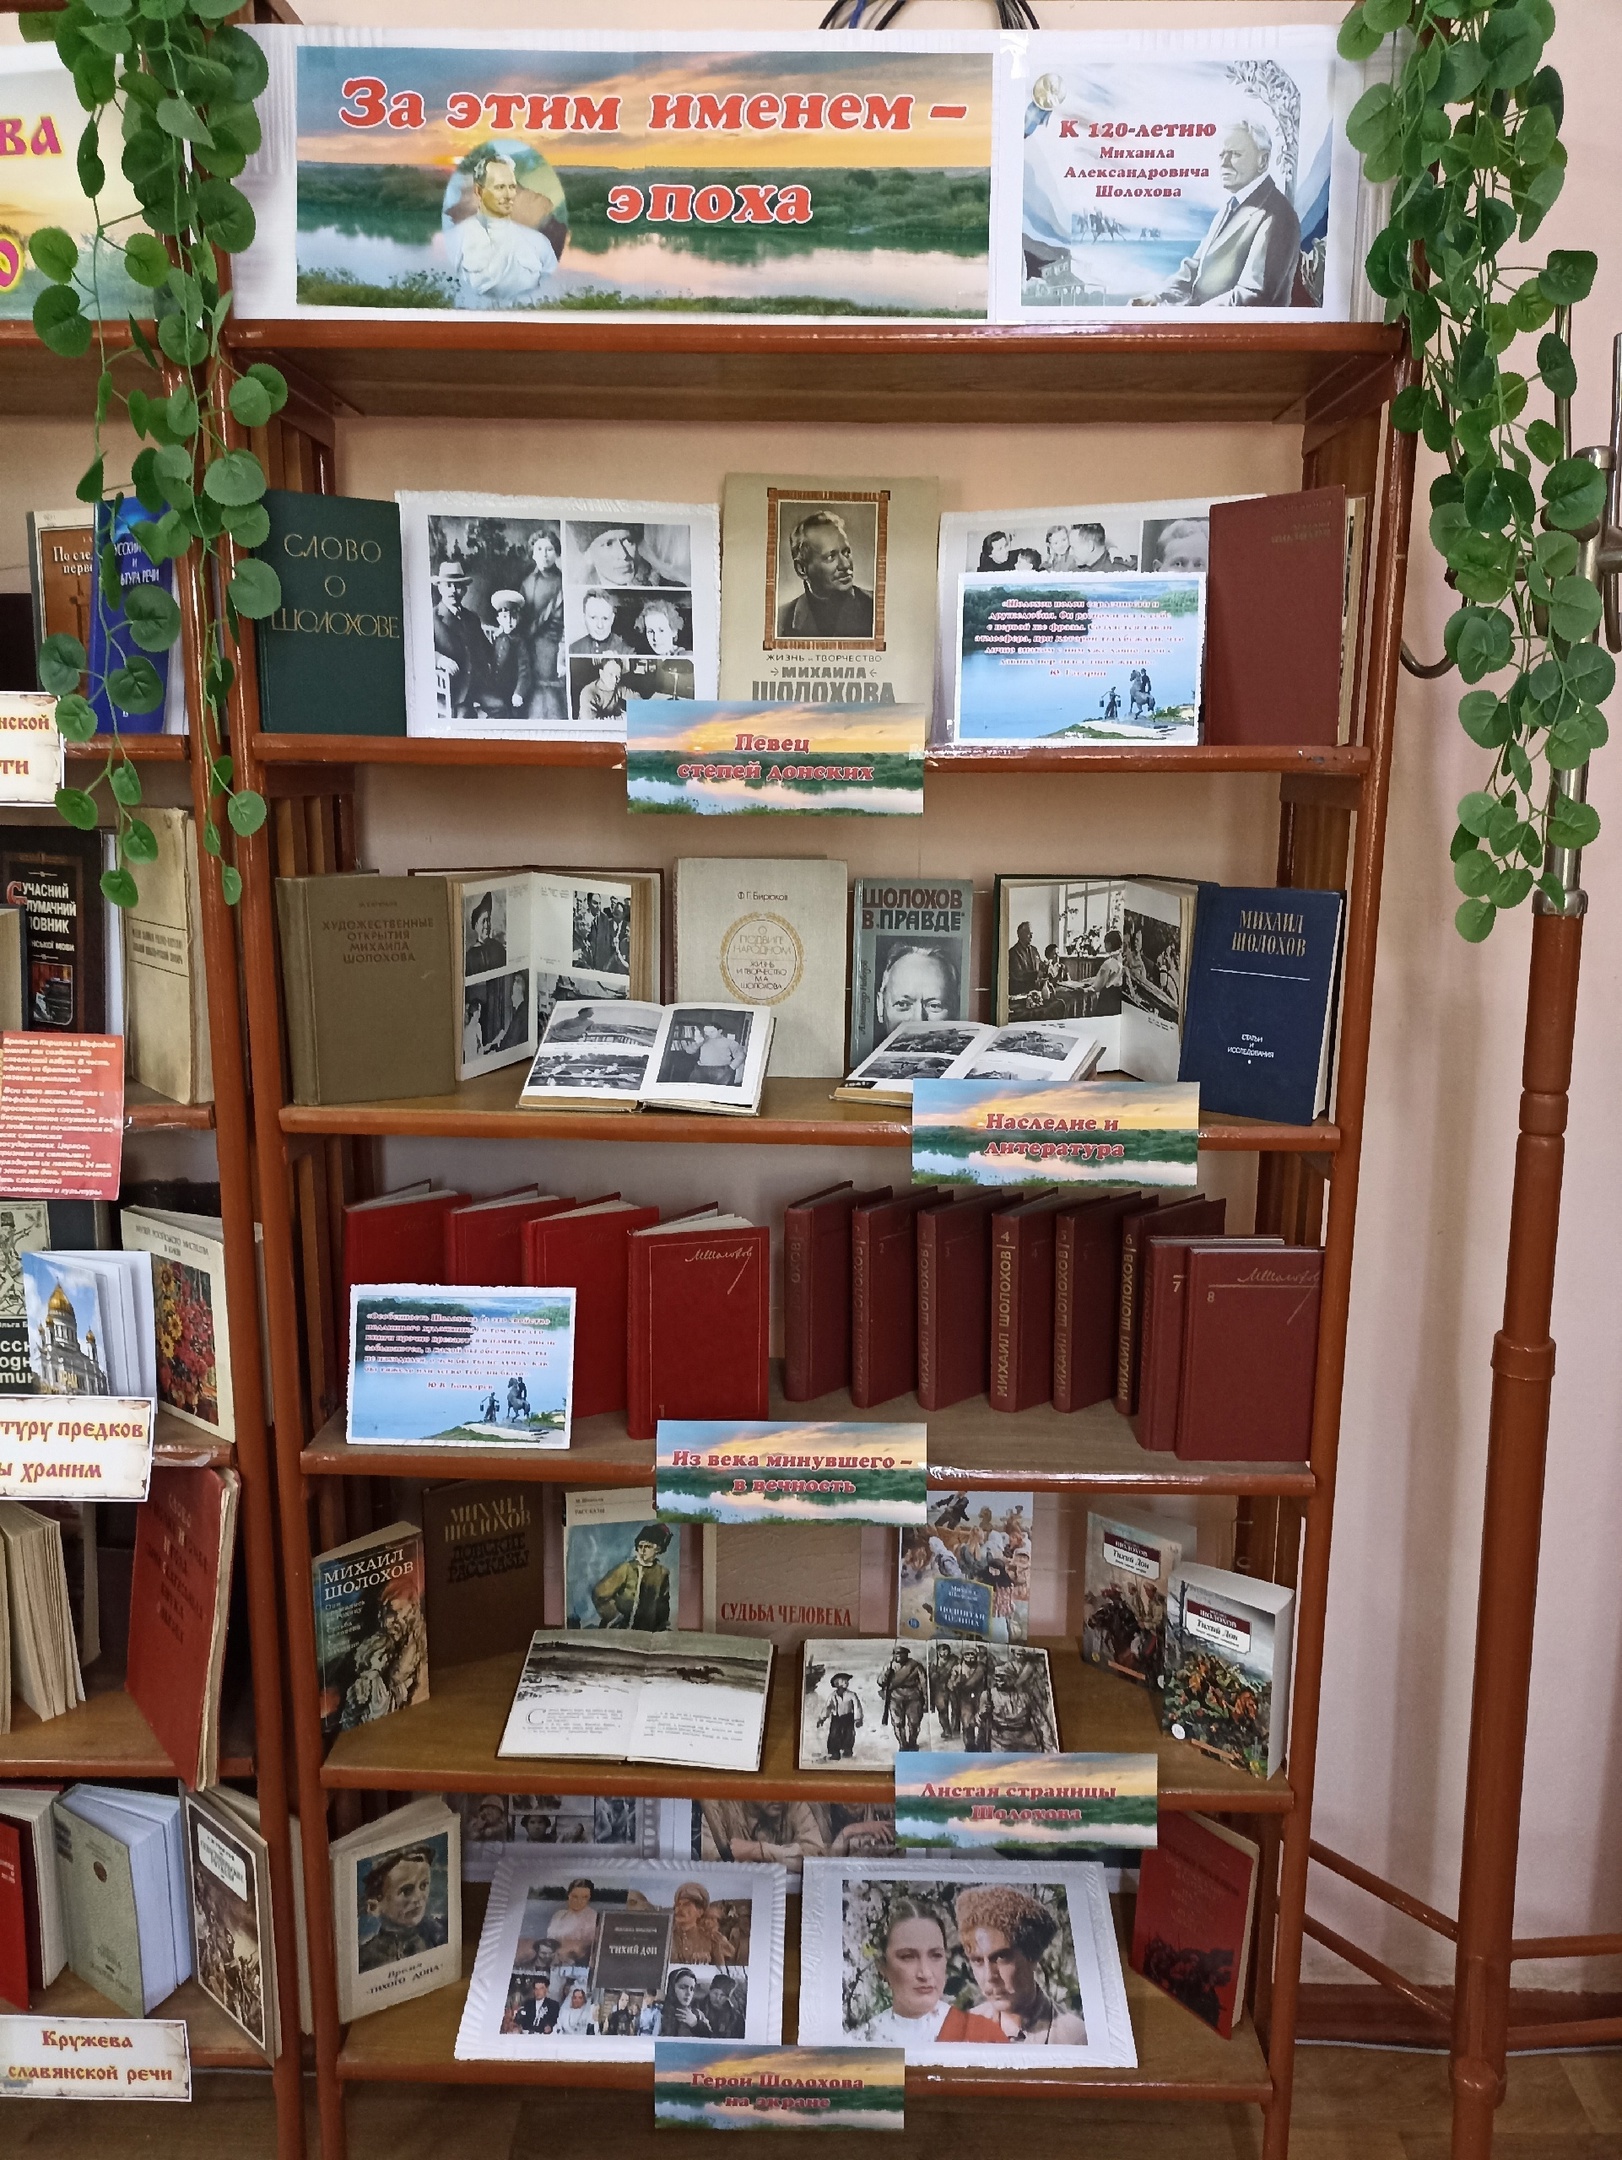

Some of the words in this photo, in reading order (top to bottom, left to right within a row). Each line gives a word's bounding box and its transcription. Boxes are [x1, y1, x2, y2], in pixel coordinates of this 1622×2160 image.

[338, 75, 426, 131] За
[445, 90, 623, 133] этим
[648, 92, 911, 132] именем
[1059, 120, 1079, 139] К
[1088, 119, 1217, 140] 120-летию
[1099, 145, 1175, 161] Михаила
[1064, 165, 1210, 182] Александровича
[1095, 184, 1182, 200] Шолохова
[606, 182, 812, 225] эпоха
[53, 546, 70, 562] По
[73, 550, 93, 561] сле
[284, 533, 382, 564] СЛОВО
[324, 575, 347, 598] О
[271, 609, 400, 640] ШОЛОХОВЕ
[766, 654, 804, 662] ЖИЗНЬ
[815, 654, 882, 663] ТВОРЧЕСТВО
[782, 666, 866, 679] МИХАИЛА
[752, 680, 896, 703] ШОЛОХОВА
[735, 733, 810, 754] Певец
[677, 760, 761, 780] степей
[766, 763, 874, 781] донских
[863, 888, 962, 909] ШОЛОХОВ
[29, 916, 70, 934] ОВНИК
[322, 918, 434, 931] ХУДОЖЕСТВЕННЫЕ
[862, 910, 874, 930] В
[1239, 910, 1304, 934] МИХАИЛ
[347, 930, 410, 941] ОТКРЫТИЯ
[1231, 932, 1307, 957] ШОЛОХОВ
[350, 941, 409, 952] МИХАИЛА
[343, 952, 416, 964] ШОЛОХОВА
[1227, 1046, 1275, 1059] ИССЛЕДОВАНИЯ
[985, 1113, 1097, 1132] Наследие
[1104, 1117, 1119, 1132] и
[985, 1141, 1125, 1158] литература
[1000, 1231, 1011, 1243] 4
[920, 1248, 930, 1325] ШОЛОХОВ
[998, 1251, 1012, 1328] ШОЛОХОВ
[1057, 1250, 1069, 1327] ШОЛОХОВ
[1121, 1253, 1134, 1331] ШОЛОХОВ
[1173, 1281, 1181, 1293] 7
[1207, 1291, 1216, 1303] 8
[997, 1333, 1010, 1398] МИХАИЛ
[1056, 1332, 1067, 1396] МИХАИЛ
[1118, 1339, 1130, 1401] МИХАИЛ
[57, 1421, 143, 1442] предков
[672, 1451, 701, 1467] Из
[708, 1454, 759, 1467] века
[766, 1454, 895, 1471] минувшего
[20, 1463, 102, 1483] храним
[733, 1479, 746, 1492] в
[753, 1478, 856, 1494] вечность
[450, 1495, 524, 1523] МИХАИЛ
[444, 1509, 531, 1543] ШОЛОХОВ
[323, 1548, 404, 1585] МИХАИЛ
[324, 1561, 414, 1601] ШОЛОХОВ
[721, 1602, 774, 1623] СУДЬБА
[778, 1603, 852, 1627] ЧЕЛОВЕКА
[920, 1782, 999, 1799] Листая
[1006, 1786, 1117, 1802] страницы
[971, 1804, 1082, 1822] Шолохова
[42, 2030, 133, 2051] Кружева
[8, 2065, 118, 2081] славянской
[126, 2069, 173, 2085] речи
[690, 2072, 754, 2088] Герои
[759, 2073, 864, 2090] Шолохова
[725, 2096, 749, 2107] на
[755, 2096, 830, 2110] экране
